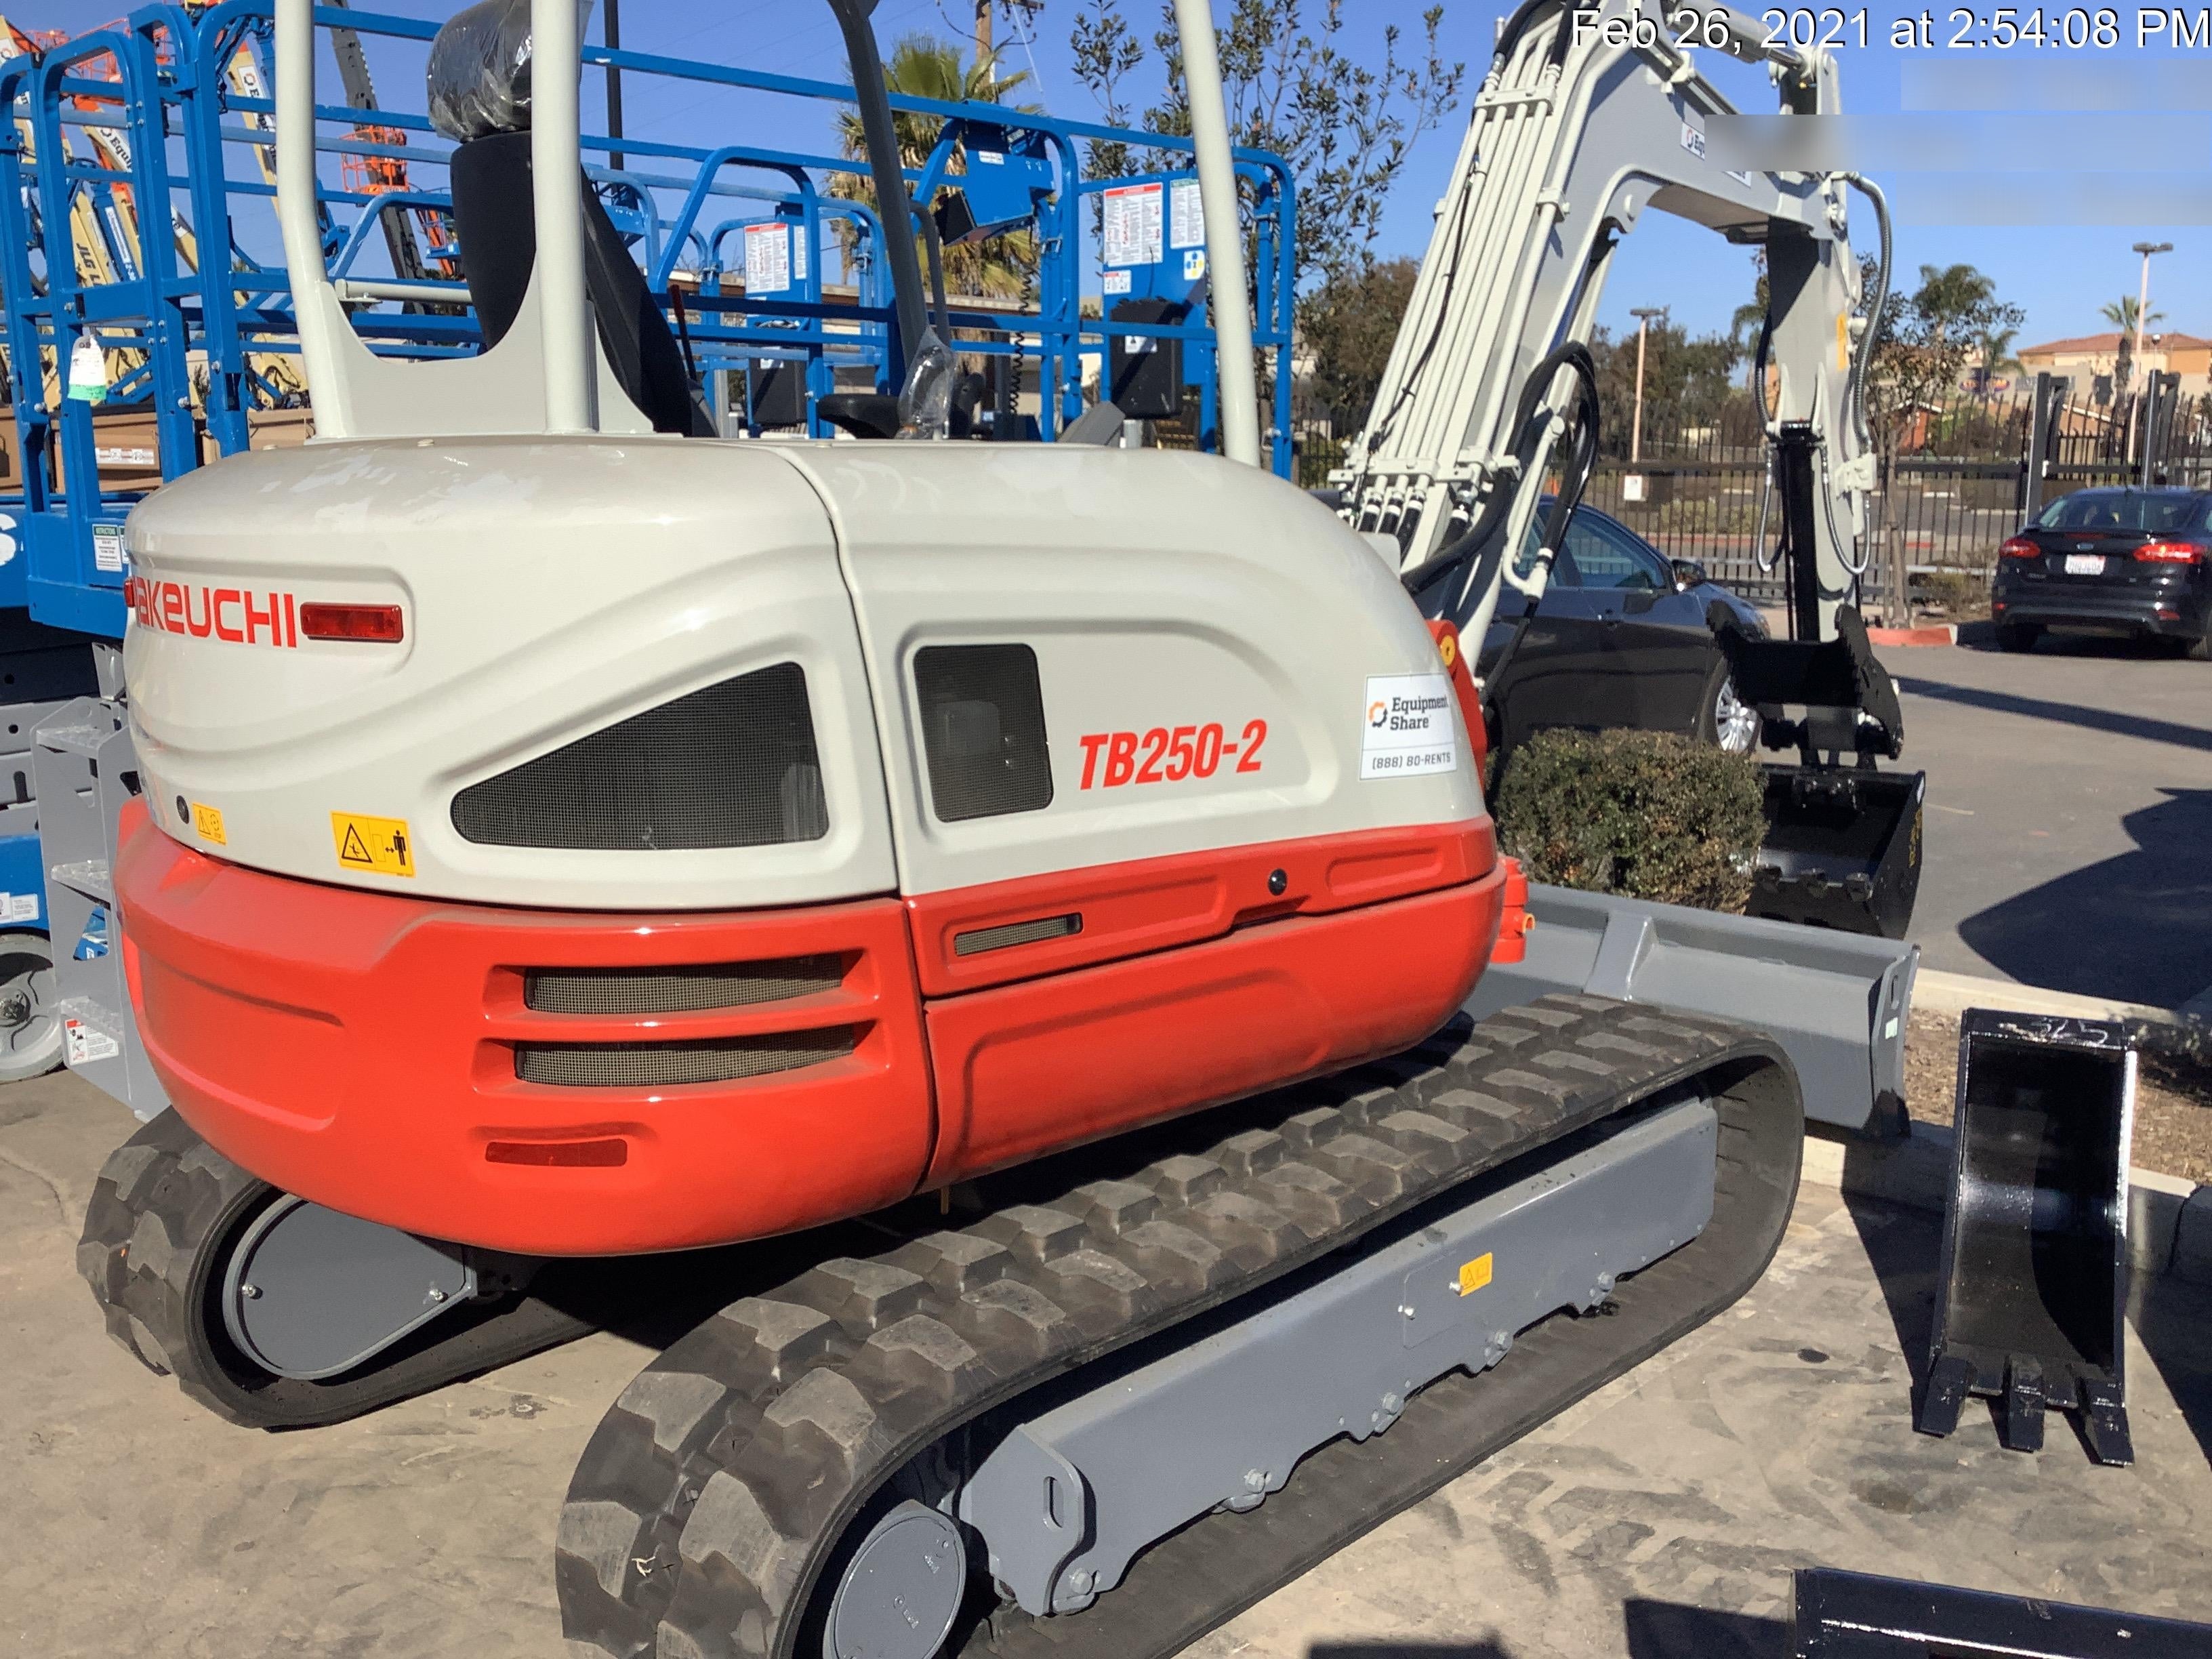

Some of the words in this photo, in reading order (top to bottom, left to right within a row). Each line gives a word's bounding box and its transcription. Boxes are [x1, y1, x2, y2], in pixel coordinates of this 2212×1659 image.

[76, 243, 96, 269] JLG
[1391, 695, 1448, 714] Equipment
[1390, 716, 1429, 731] Share
[1079, 718, 1267, 790] TB250-2
[1372, 756, 1403, 770] (888)
[1406, 752, 1451, 766] 80-RENTS
